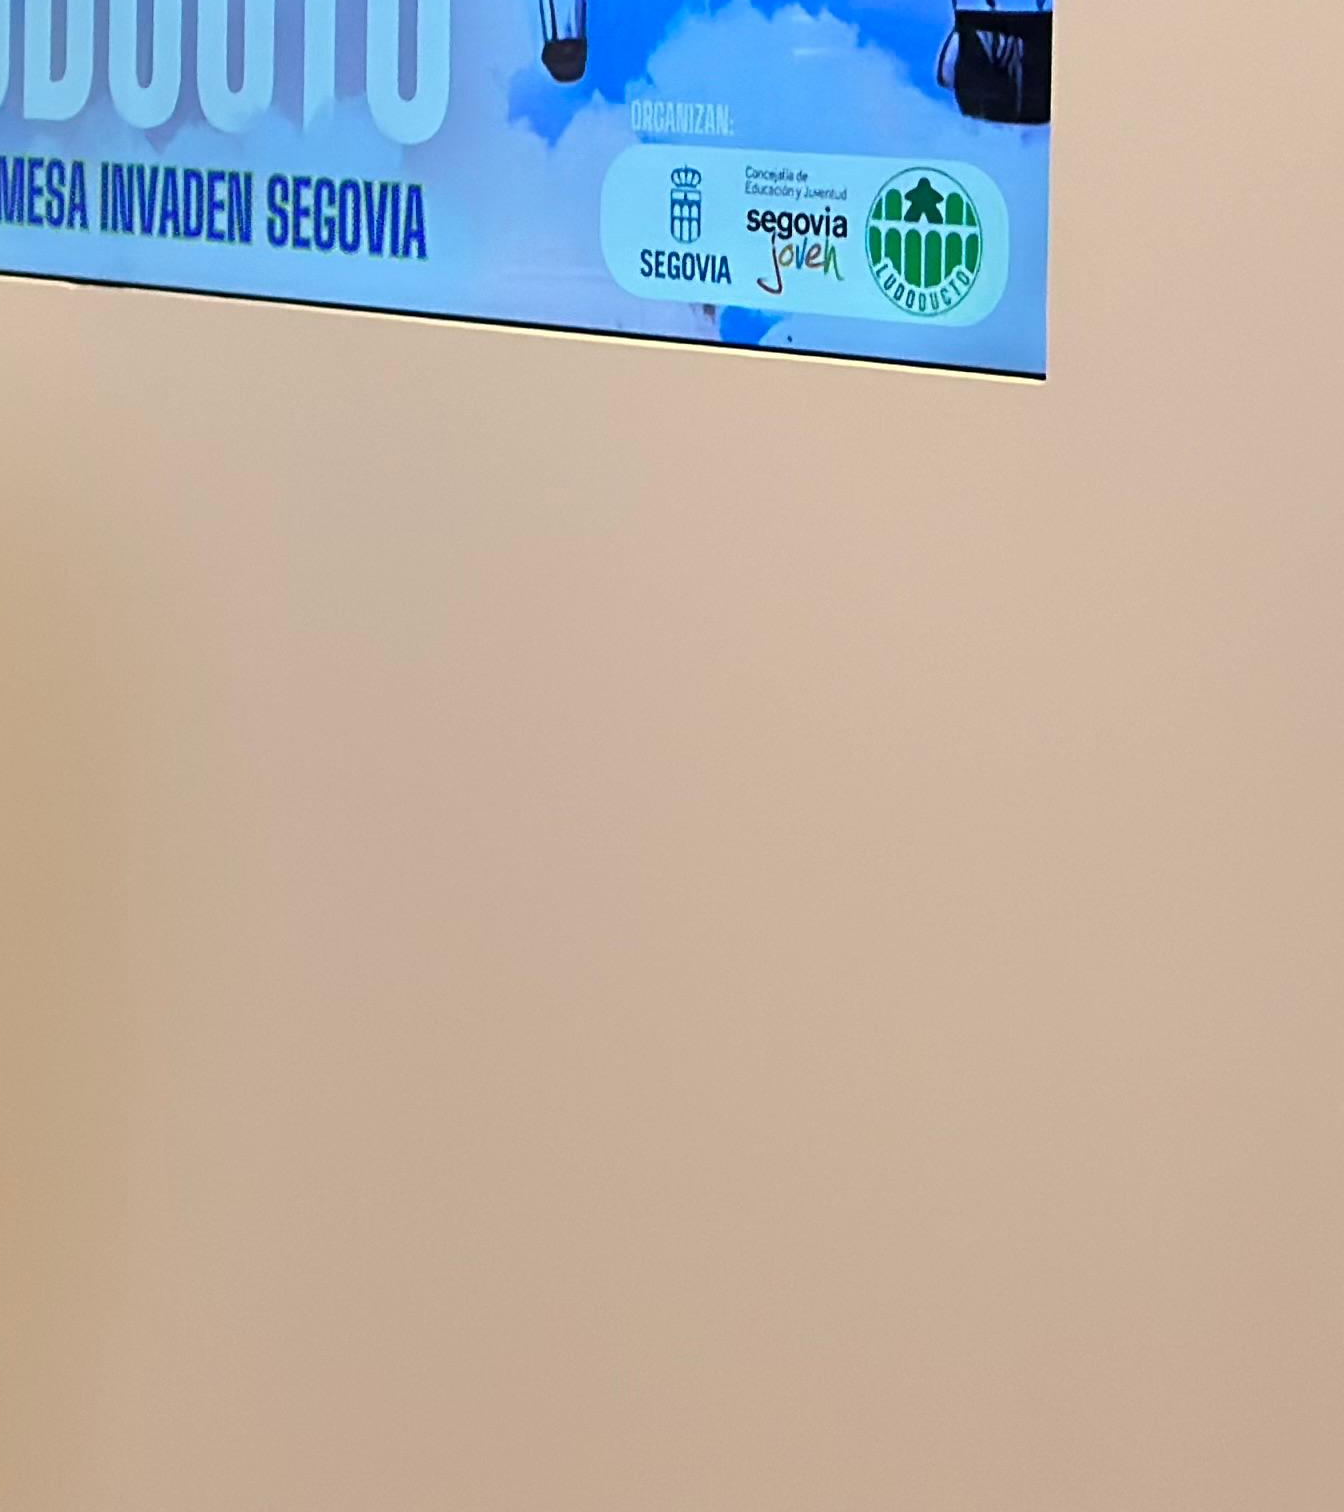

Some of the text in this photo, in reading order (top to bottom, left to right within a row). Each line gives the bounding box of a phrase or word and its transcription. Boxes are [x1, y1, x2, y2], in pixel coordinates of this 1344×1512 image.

[631, 99, 734, 136] ORGANIZAN:
[796, 170, 809, 182] de
[99, 161, 254, 246] INVADEN
[266, 172, 429, 260] SEGOVIA
[796, 187, 802, 201] y
[803, 186, 848, 201] Juventud
[746, 206, 848, 239] segovia
[640, 249, 732, 285] SEGOVIA
